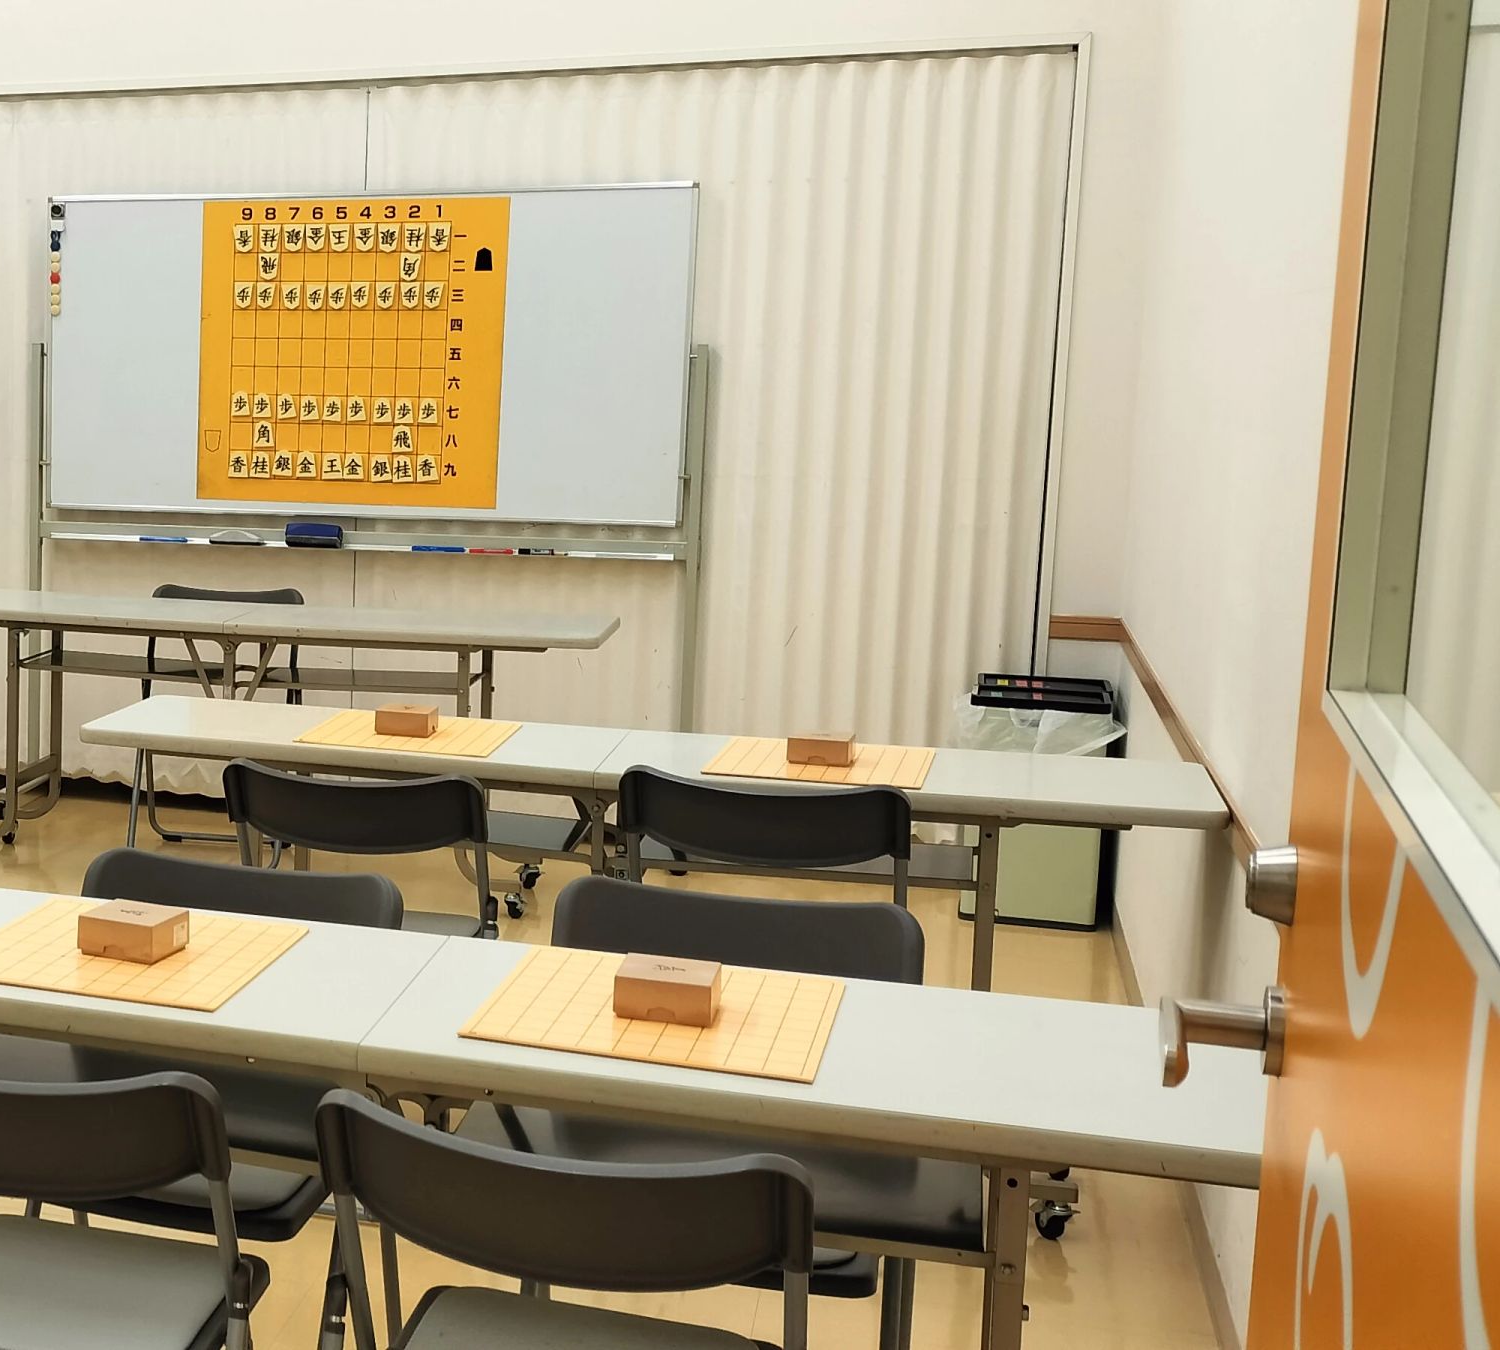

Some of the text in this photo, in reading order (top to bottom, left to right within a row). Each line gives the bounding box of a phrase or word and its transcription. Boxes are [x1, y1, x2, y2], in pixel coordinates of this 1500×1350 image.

[242, 204, 442, 220] 9 8 7 6 5 4 3 2 1
[236, 229, 252, 248] 香
[261, 228, 278, 248] 桂
[285, 228, 301, 246] 銀
[308, 227, 324, 245] 金
[356, 227, 372, 245] 金
[379, 229, 396, 247] 銀
[406, 227, 423, 248] 桂
[431, 228, 447, 247] 香
[260, 256, 419, 278] 飛 角
[453, 261, 465, 271] 二
[236, 286, 439, 305] 歩 歩 歩 歩 歩 歩 歩 歩 歩
[452, 290, 463, 301] 三
[451, 319, 462, 331] 四
[449, 348, 461, 360] 五
[448, 377, 460, 389] 六
[234, 395, 436, 419] 歩 歩 歩 歩 歩 歩 歩 歩 歩
[447, 406, 459, 418] 七
[256, 424, 411, 449] 角 飛
[446, 435, 457, 447] 八
[230, 455, 435, 480] 香 桂 銀 金 王 金 銀 桂 香
[444, 464, 456, 476] 九
